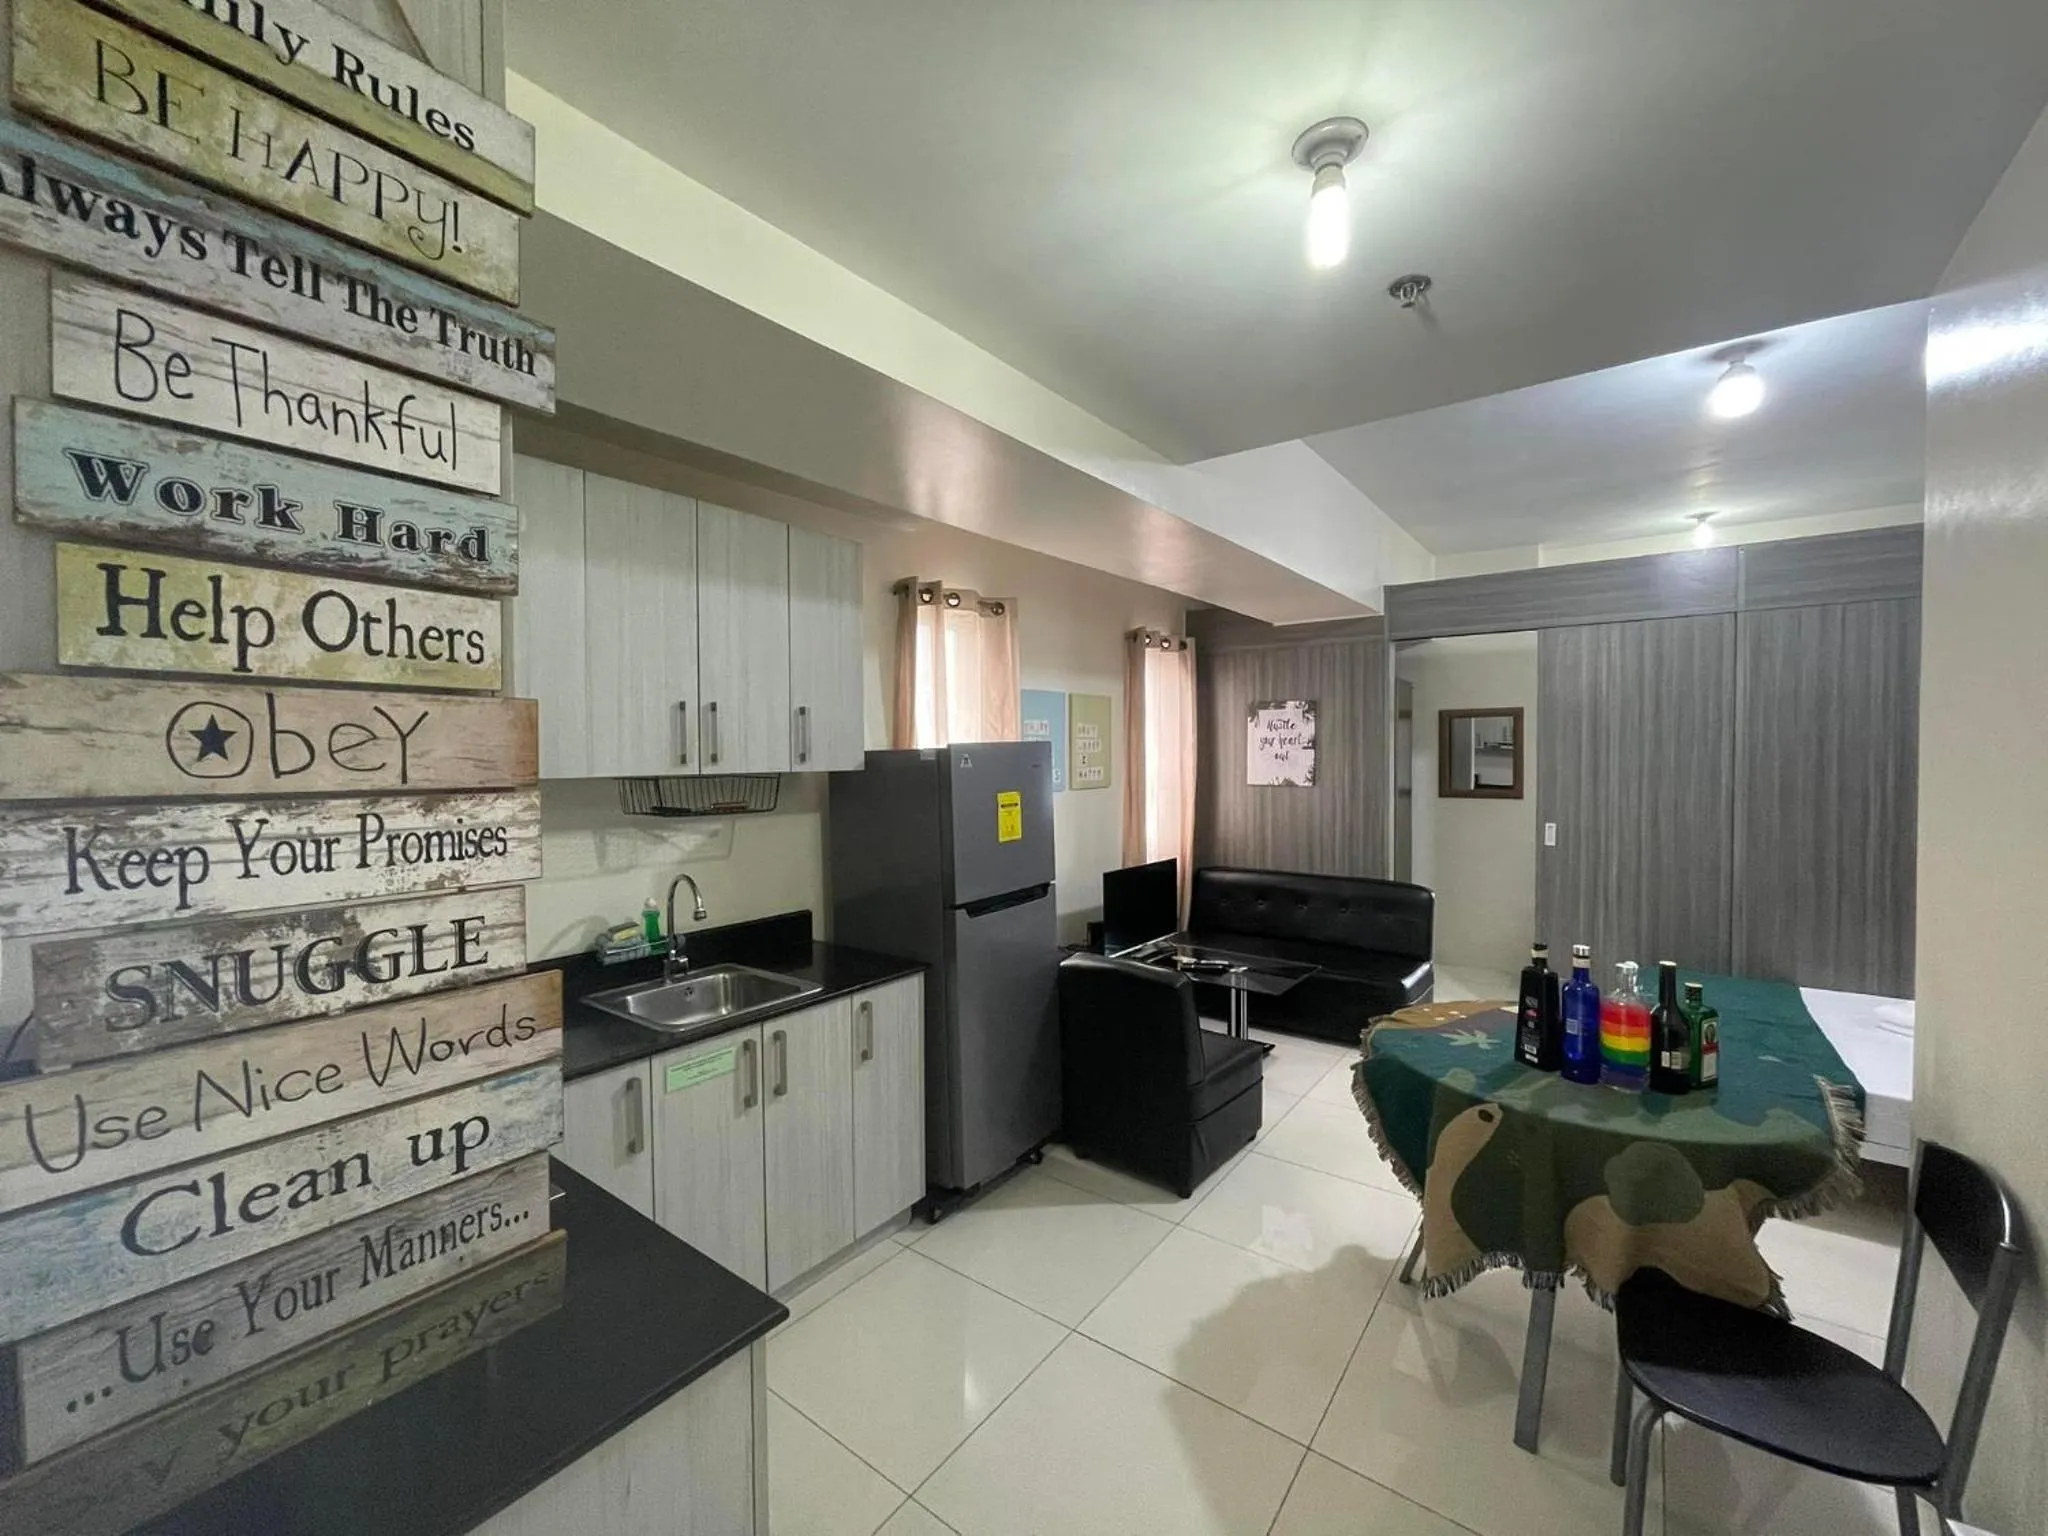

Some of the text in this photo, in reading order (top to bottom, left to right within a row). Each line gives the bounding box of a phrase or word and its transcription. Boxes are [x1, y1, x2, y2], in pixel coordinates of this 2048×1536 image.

[94, 39, 205, 144] BE
[333, 43, 477, 151] Rules
[223, 228, 325, 303] Tell
[334, 272, 419, 335] The
[430, 309, 537, 378] Truth
[114, 308, 458, 471] Be Thankful
[62, 449, 490, 563] Work Hard
[96, 563, 485, 672] Help Others
[63, 813, 508, 909] Keep Your Promises
[104, 915, 490, 1033] SNUGGLE
[24, 1003, 537, 1174] Use Nice Words
[120, 1113, 490, 1257] Clean up
[233, 1268, 341, 1336] Your
[217, 1359, 357, 1454] your
